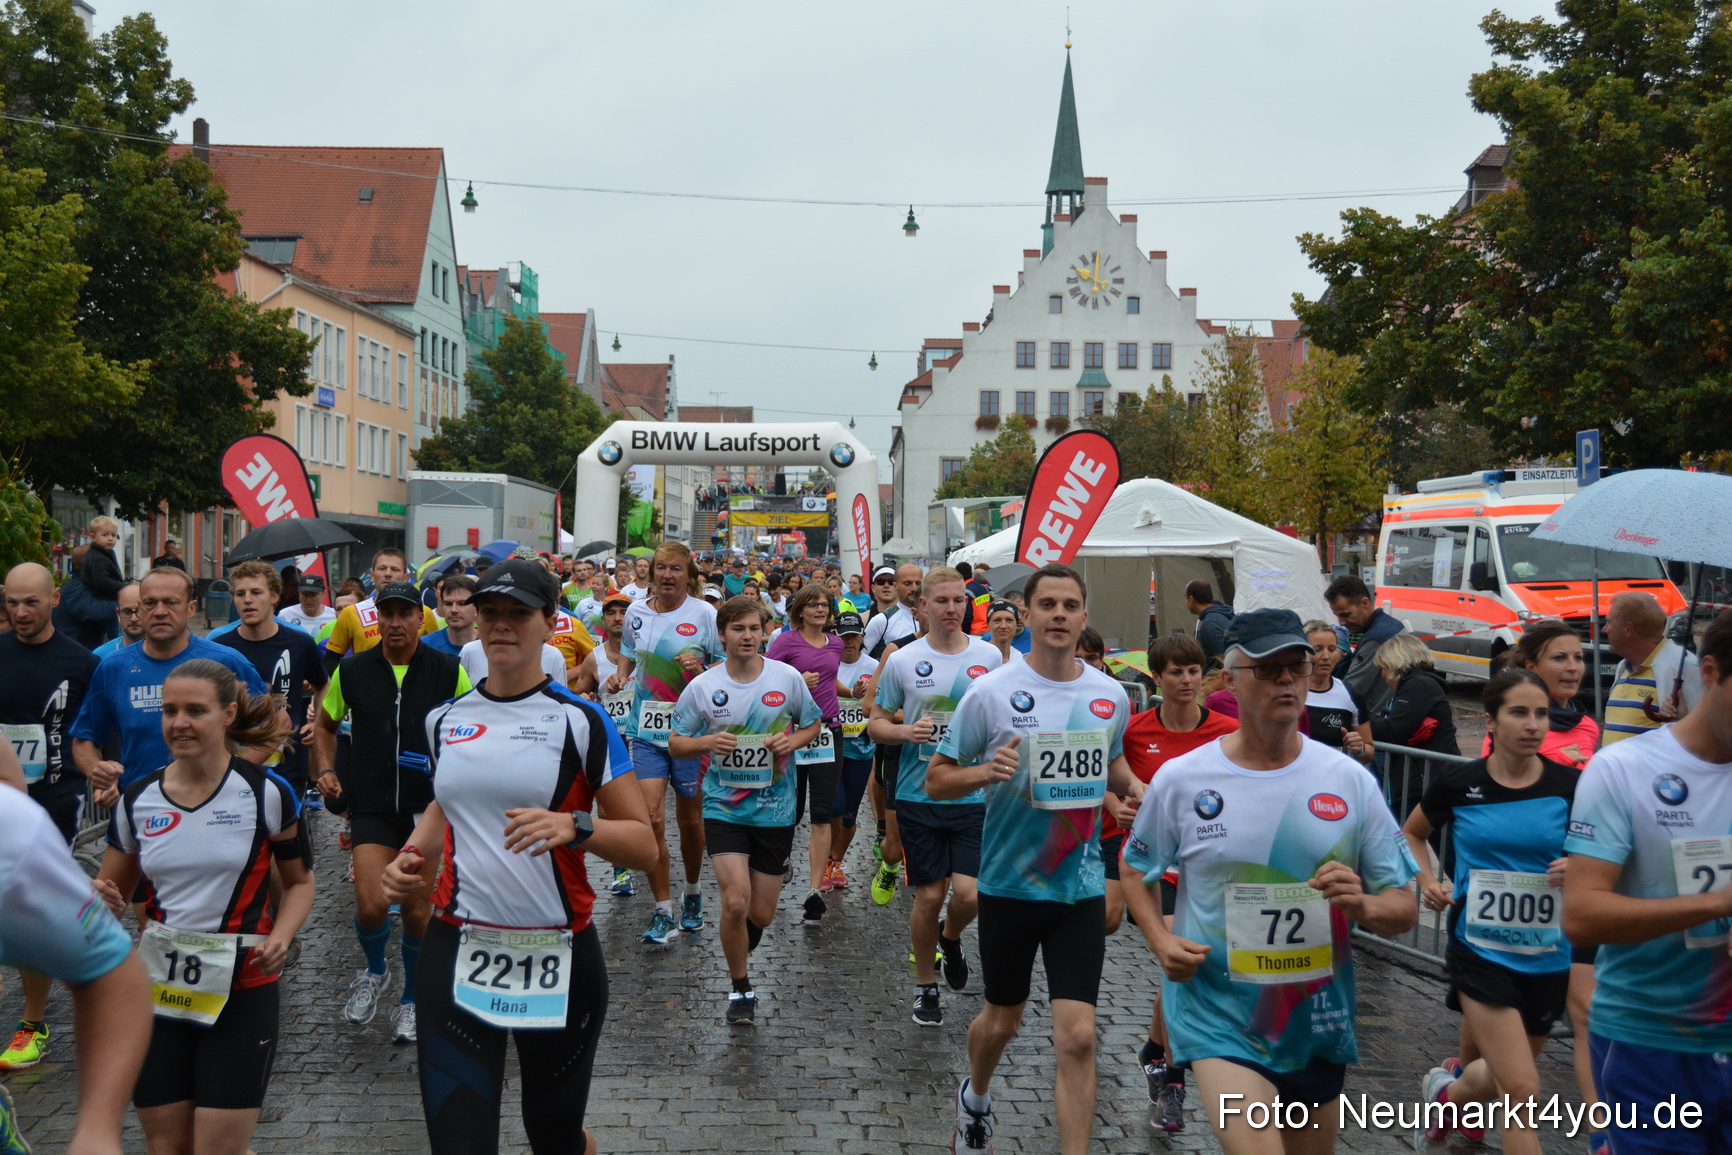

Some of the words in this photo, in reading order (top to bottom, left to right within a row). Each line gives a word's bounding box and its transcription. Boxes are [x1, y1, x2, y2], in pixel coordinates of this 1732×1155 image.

[631, 430, 698, 451] BMW
[704, 432, 821, 456] Laufsport
[1581, 439, 1594, 480] P
[1522, 469, 1578, 481] EINSATZLEITU
[1025, 450, 1107, 569] REWE
[768, 515, 791, 525] ZIEL
[1012, 716, 1039, 724] PARTL
[449, 725, 475, 737] tkn
[510, 734, 538, 742] nürnberg
[652, 733, 669, 742] Achi
[1067, 731, 1103, 744] BOCK
[1039, 748, 1103, 779] 2488
[729, 772, 760, 782] Andreas
[1049, 786, 1095, 799] Christian
[1655, 809, 1694, 821] PARTL
[145, 815, 169, 830] tkn
[1196, 823, 1228, 835] PARTL
[1656, 819, 1695, 828] Neumarkt
[1197, 831, 1228, 842] Neumarkt
[1477, 890, 1555, 924] 2009
[1260, 908, 1305, 945] 72
[508, 932, 562, 946] BOCK
[1481, 927, 1544, 946] CAROLIN
[164, 950, 203, 985] 18
[467, 949, 561, 990] 2218
[1255, 955, 1311, 970] Thomas
[160, 989, 192, 1007] Anne
[490, 998, 528, 1014] Hana
